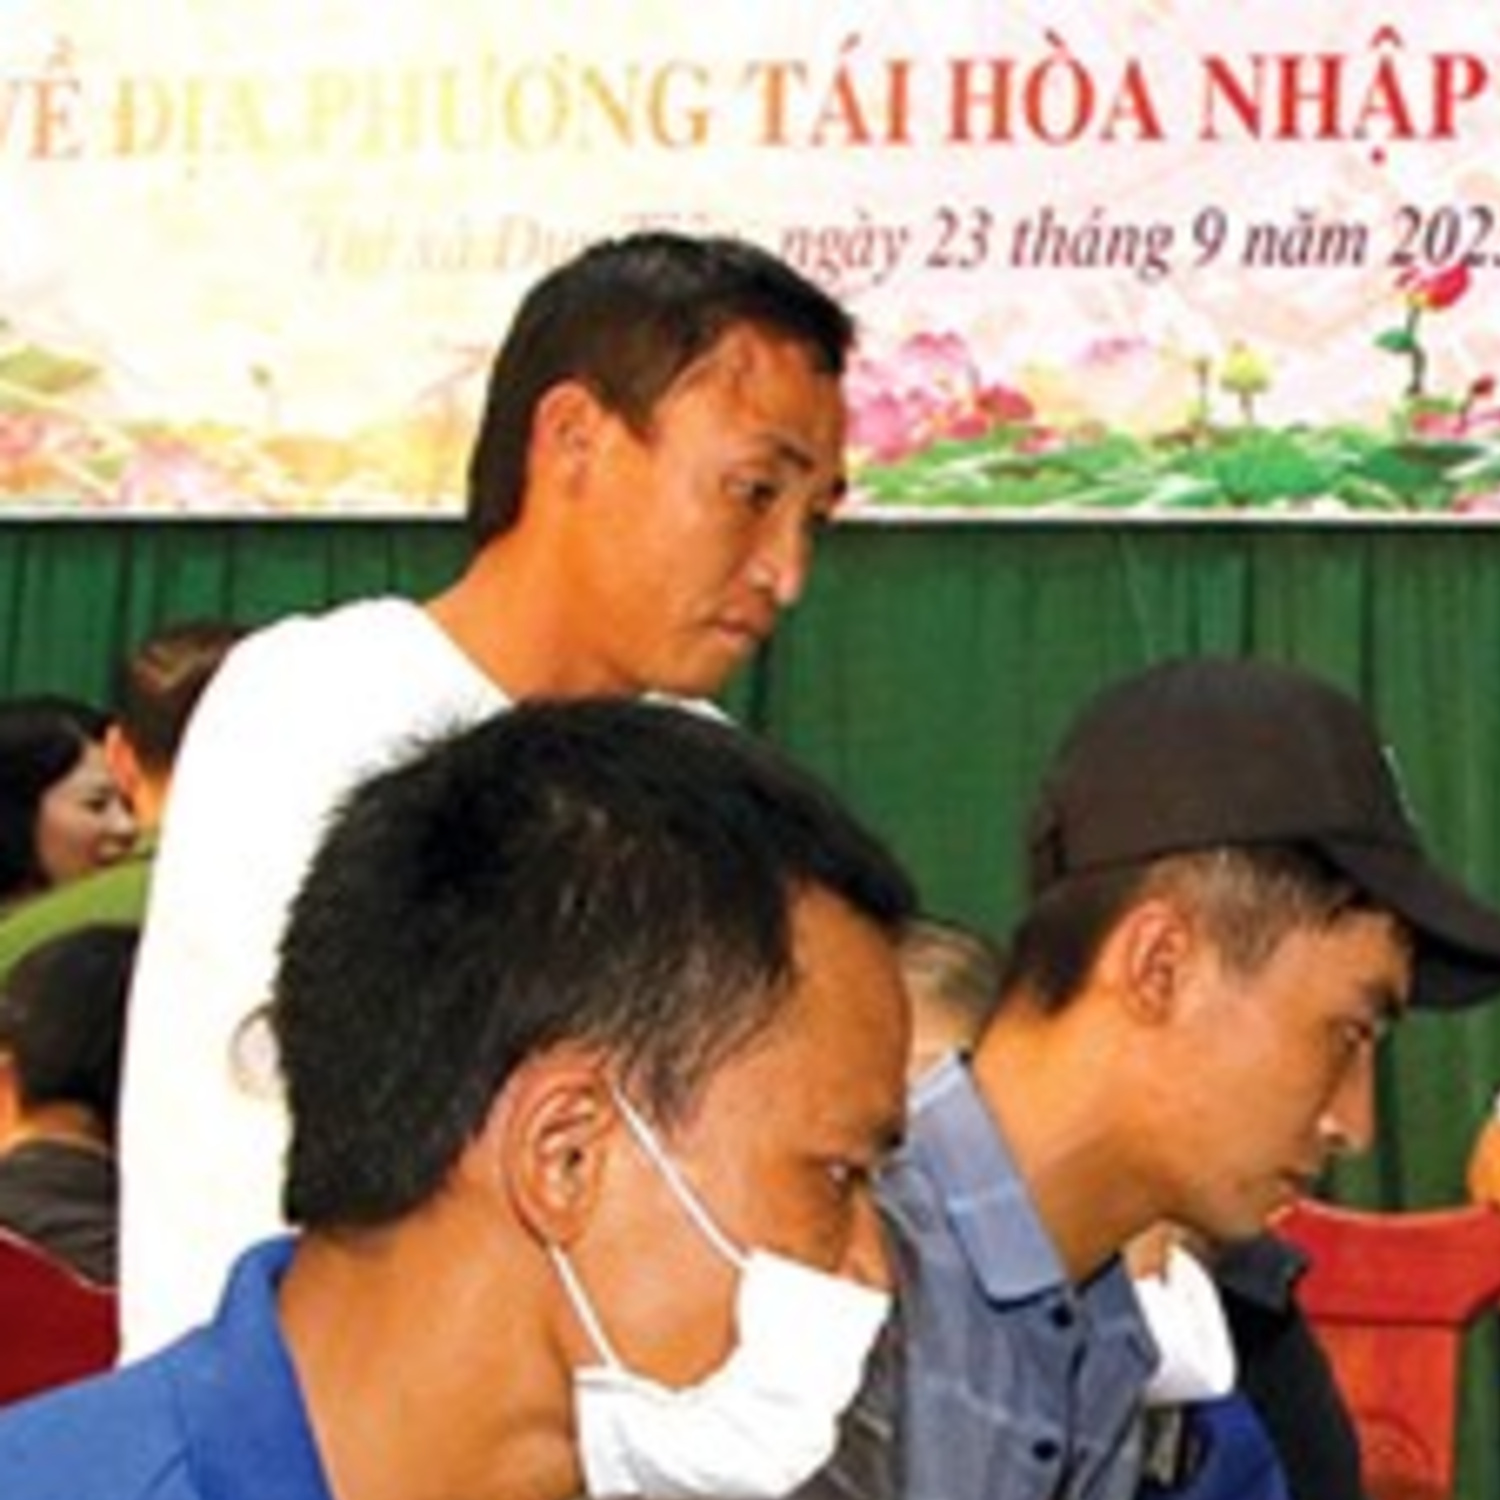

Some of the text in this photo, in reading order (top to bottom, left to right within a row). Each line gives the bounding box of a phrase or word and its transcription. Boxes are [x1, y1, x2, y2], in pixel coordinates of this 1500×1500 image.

[303, 52, 713, 155] PHƯƠNG
[744, 32, 912, 147] TÁI
[945, 28, 1166, 146] HÒA
[1198, 24, 1489, 166] NHẬP
[781, 207, 909, 292] ngày
[923, 206, 994, 270] 23
[1008, 205, 1175, 284] tháng
[1190, 205, 1228, 270] 9
[1239, 208, 1370, 270] năm
